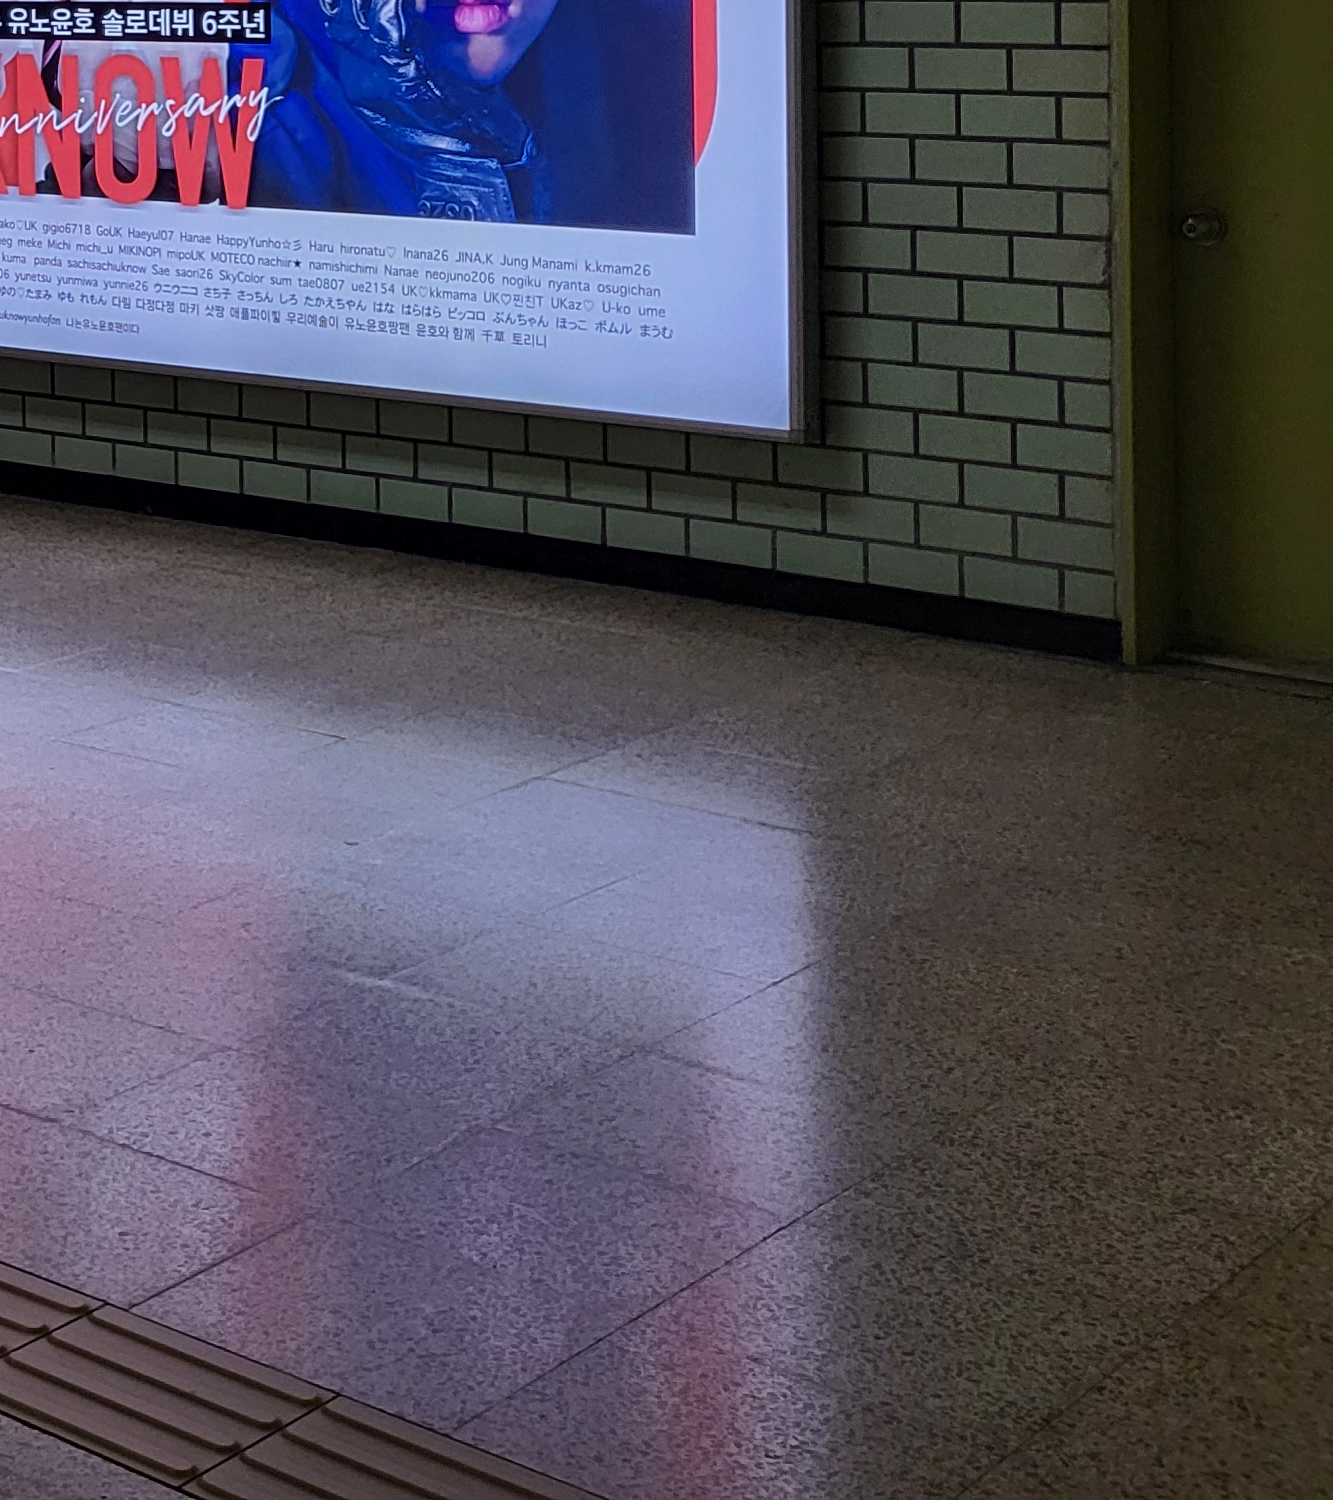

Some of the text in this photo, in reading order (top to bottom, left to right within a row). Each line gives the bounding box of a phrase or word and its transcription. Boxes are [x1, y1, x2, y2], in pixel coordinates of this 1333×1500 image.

[8, 7, 96, 36] 유노윤호
[101, 8, 195, 38] 솔로데뷔
[201, 8, 266, 39] 6주년
